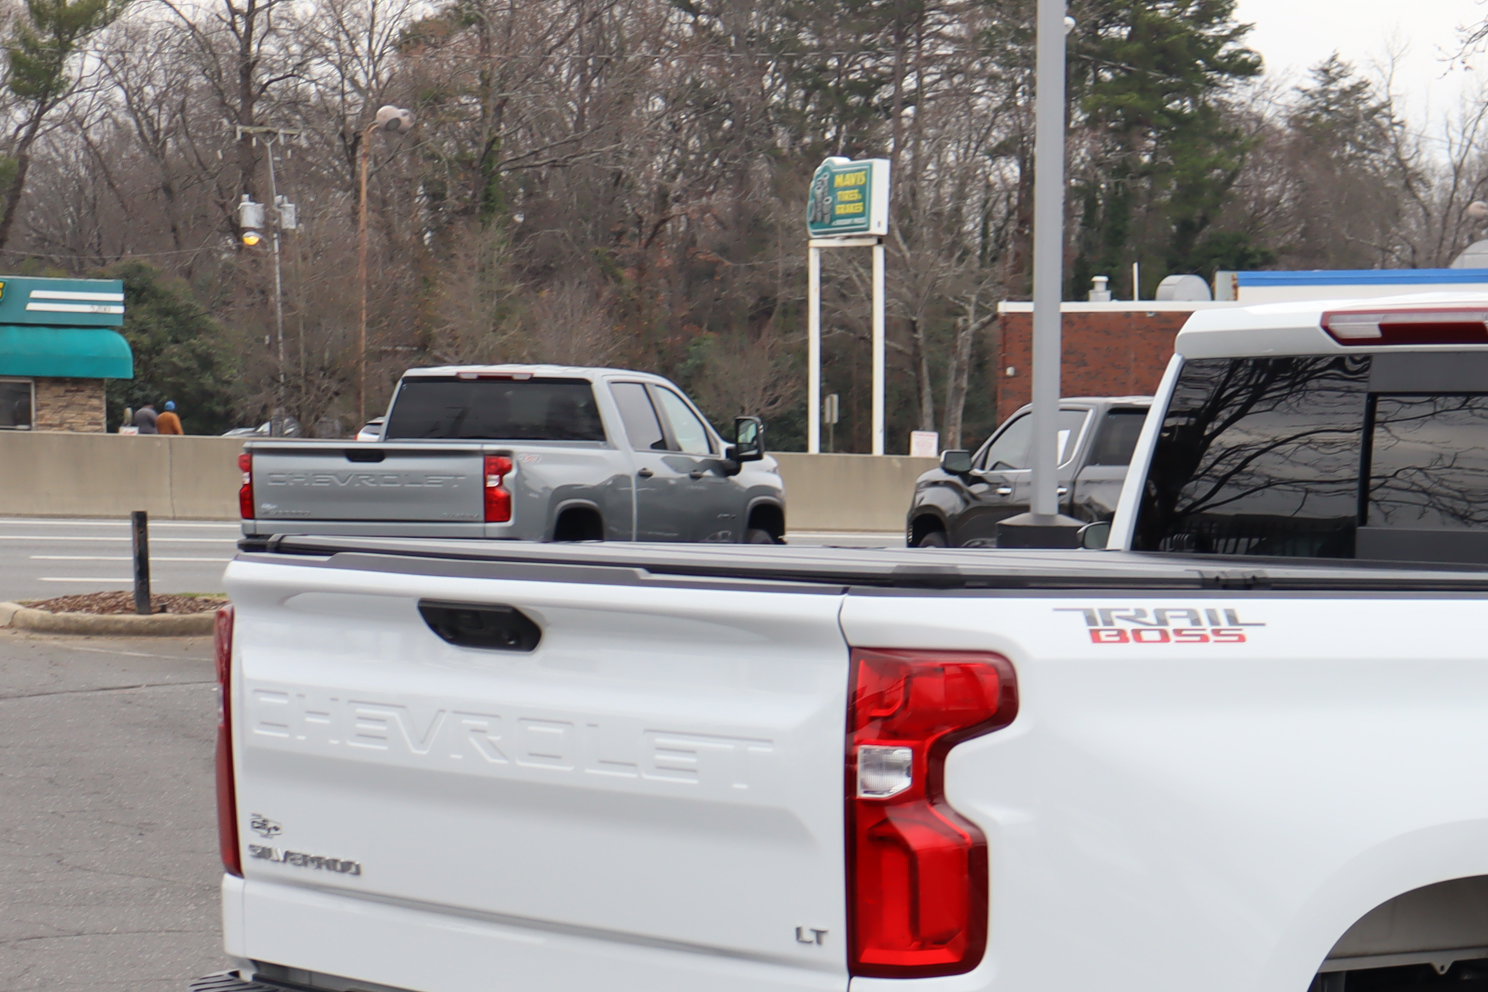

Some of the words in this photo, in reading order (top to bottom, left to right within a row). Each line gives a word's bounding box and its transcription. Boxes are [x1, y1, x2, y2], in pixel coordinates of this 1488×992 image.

[267, 472, 466, 488] CHEVROLET
[1052, 608, 1266, 627] TRAIL
[1088, 628, 1247, 644] BOSS
[252, 688, 775, 789] CHEVROLET
[248, 844, 361, 876] SILVERADO
[795, 926, 829, 946] LT
